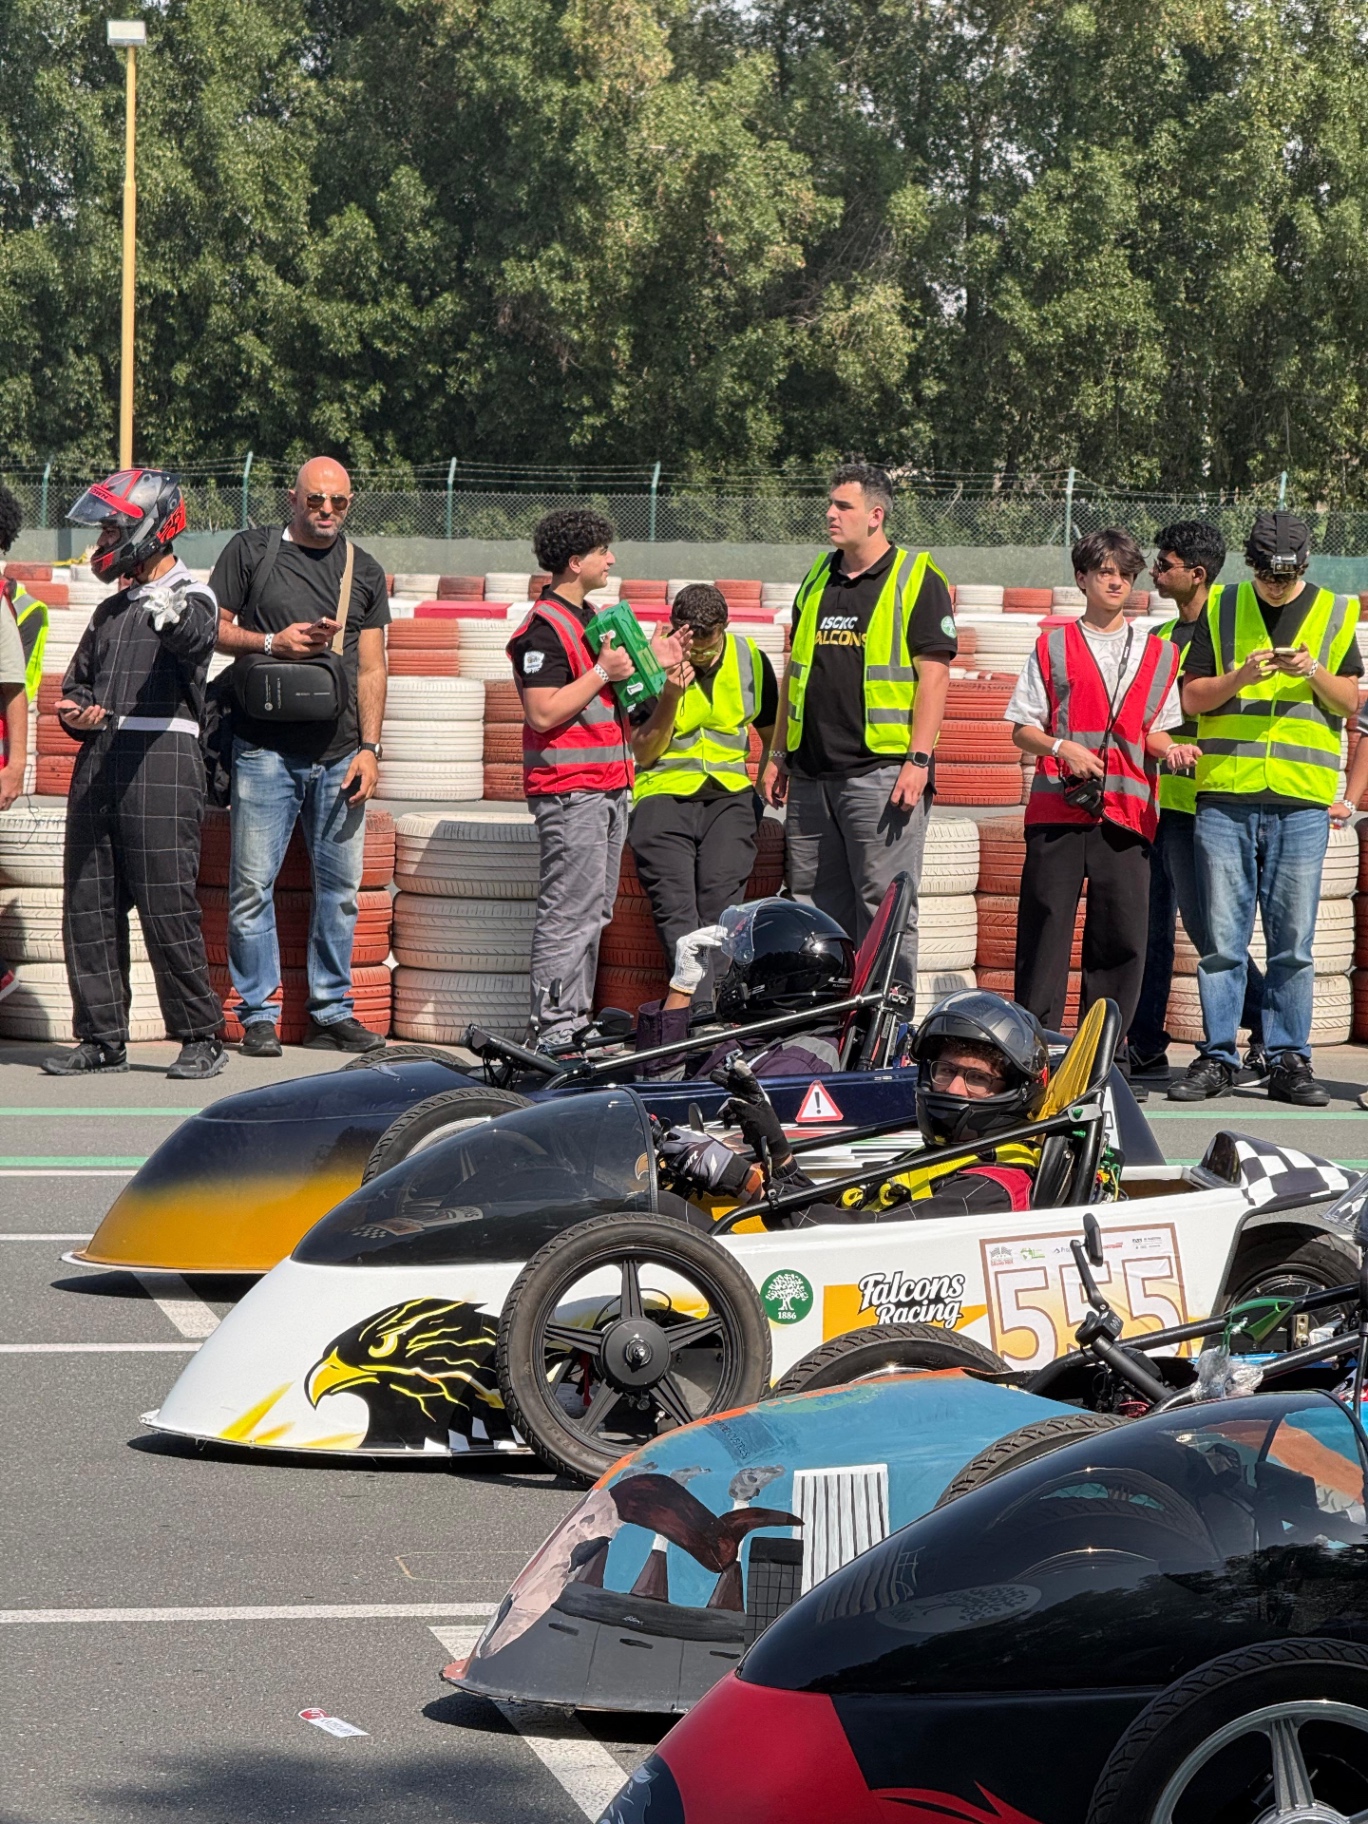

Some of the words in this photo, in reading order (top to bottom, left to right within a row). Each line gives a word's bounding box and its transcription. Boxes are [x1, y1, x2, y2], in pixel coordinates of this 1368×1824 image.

[819, 616, 858, 630] ISCKC
[815, 630, 867, 647] ALCONS
[857, 1270, 966, 1316] Falcons
[777, 1311, 797, 1320] 1886
[875, 1301, 965, 1329] Racing
[995, 1255, 1183, 1368] 555
